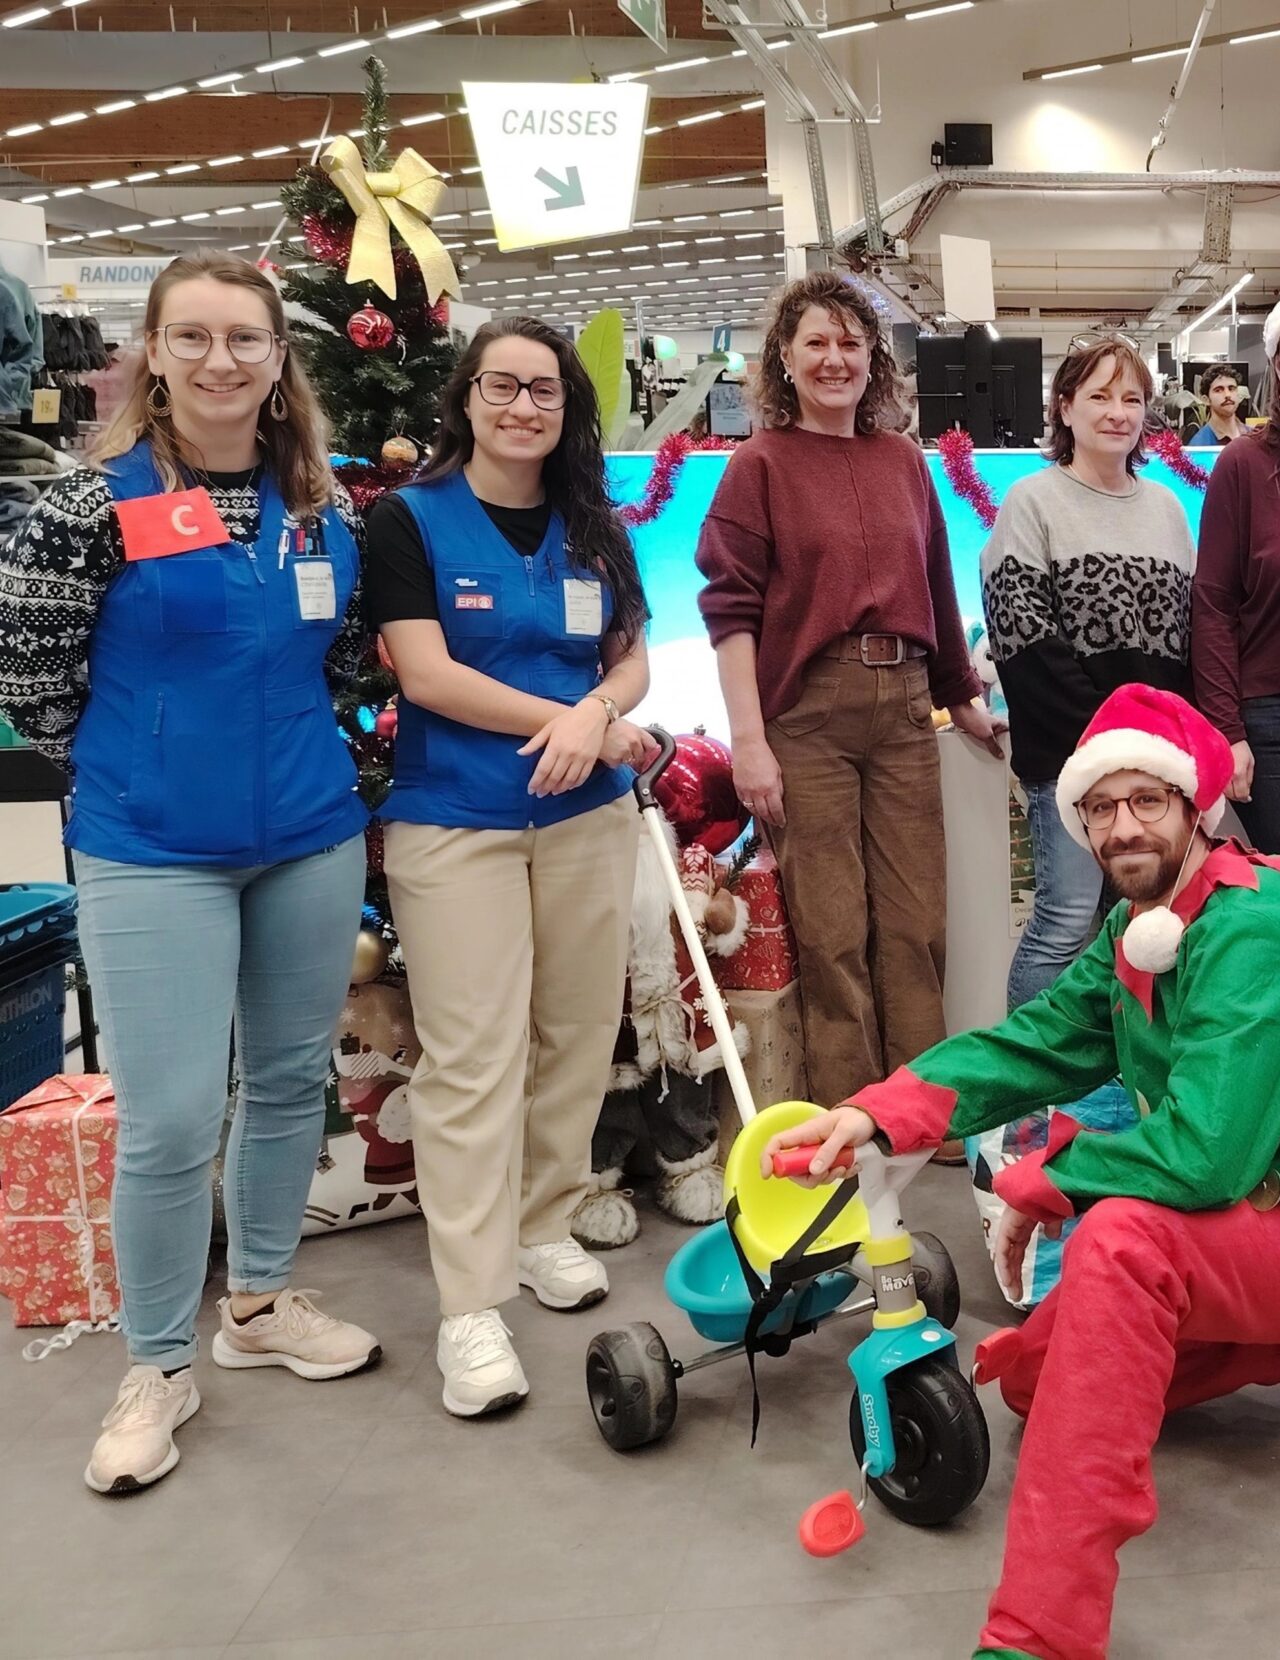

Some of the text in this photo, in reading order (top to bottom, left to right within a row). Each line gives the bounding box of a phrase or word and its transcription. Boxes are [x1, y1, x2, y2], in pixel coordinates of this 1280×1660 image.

[502, 109, 617, 136] CAISSES
[717, 330, 727, 352] 4
[171, 505, 200, 536] C
[457, 597, 477, 608] EPI
[862, 1393, 880, 1448] Smoby
